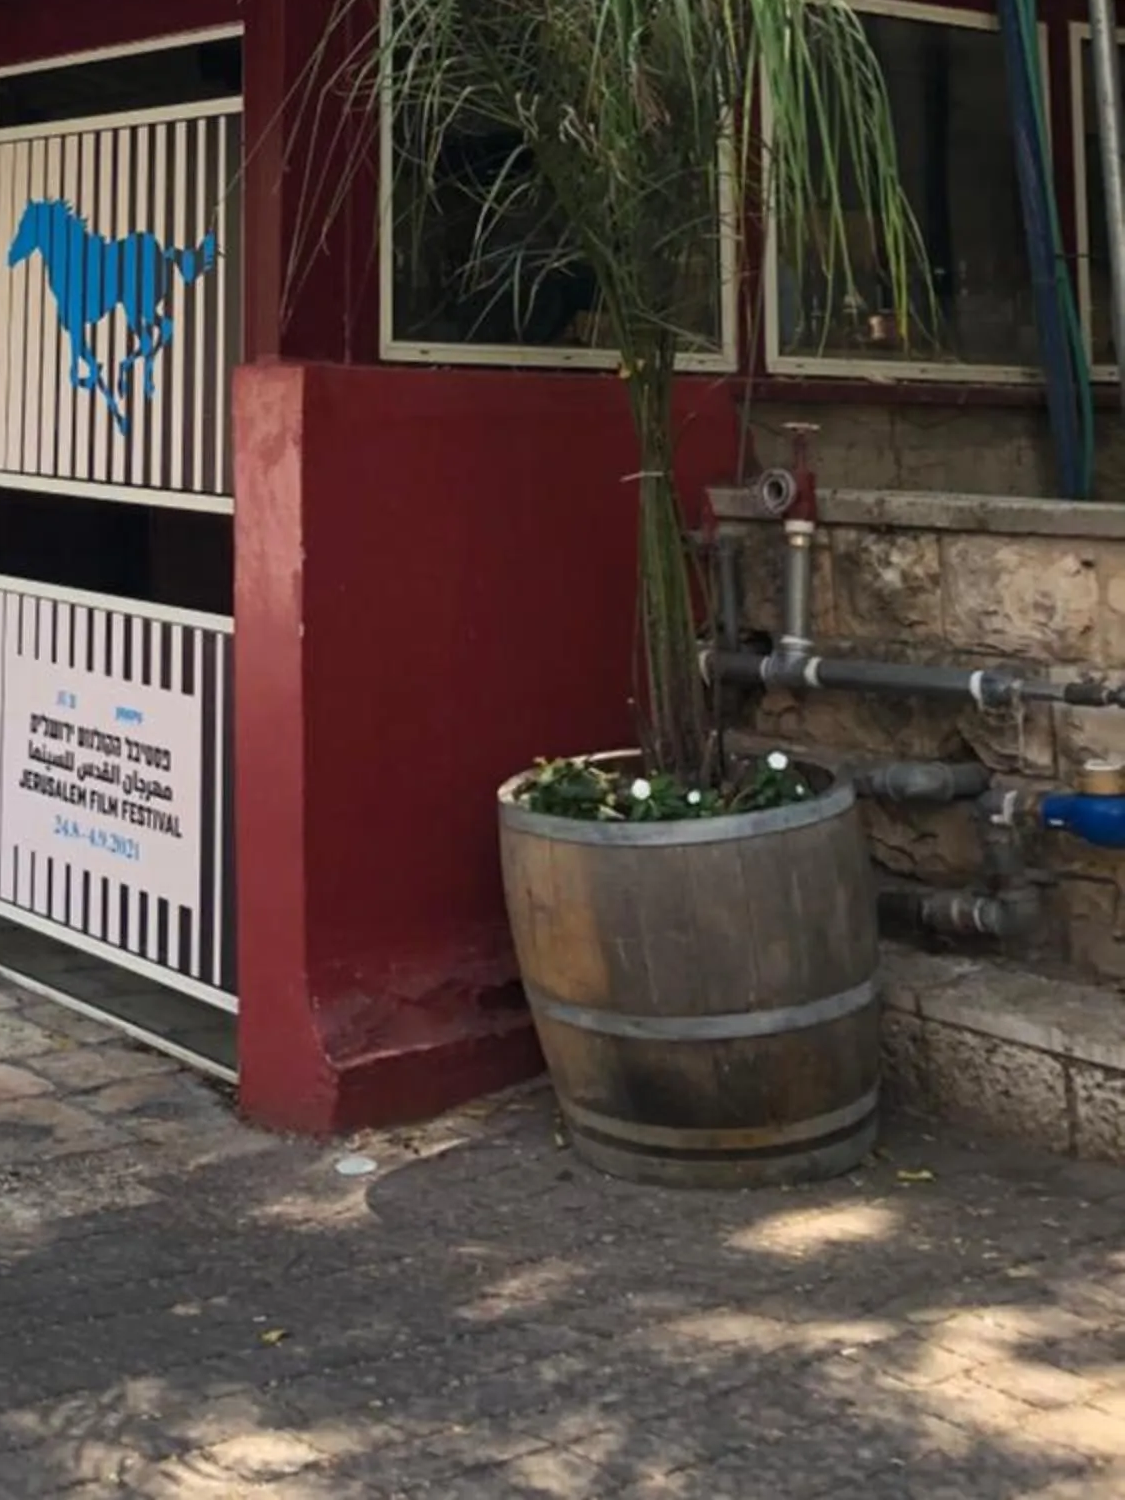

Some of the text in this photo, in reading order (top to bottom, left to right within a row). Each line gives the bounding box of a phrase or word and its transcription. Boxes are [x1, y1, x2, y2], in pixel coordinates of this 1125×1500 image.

[19, 769, 184, 838] JERUSALEM FILM FESTIVAL
